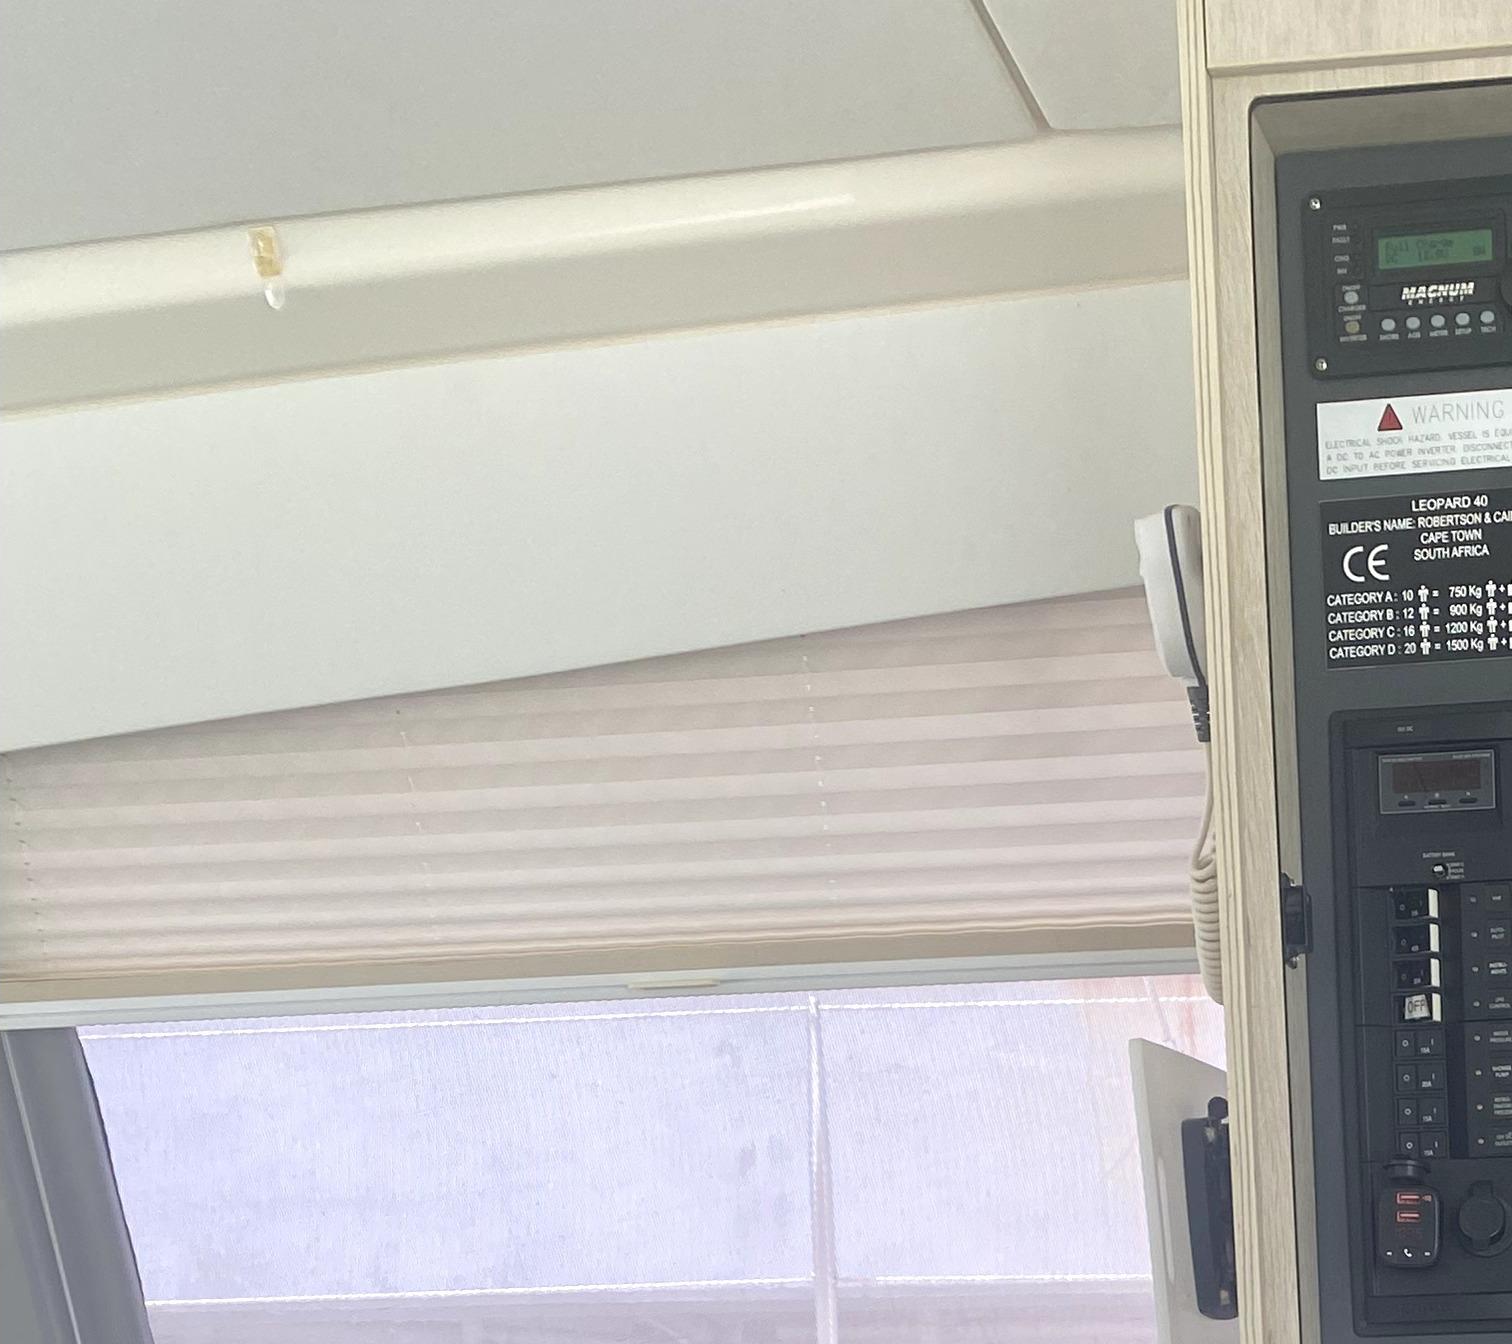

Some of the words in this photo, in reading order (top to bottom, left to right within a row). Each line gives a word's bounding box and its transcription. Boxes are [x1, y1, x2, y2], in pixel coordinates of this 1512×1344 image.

[1402, 282, 1474, 300] MAGNUM
[1412, 400, 1504, 423] WARNING
[1325, 439, 1371, 449] ELECTRICAL
[1377, 436, 1402, 446] SHOCK
[1448, 431, 1477, 440] VESSEL
[1482, 429, 1489, 438] IS
[1337, 453, 1348, 461] DC
[1354, 452, 1364, 460] TO
[1369, 451, 1379, 459] AC
[1385, 448, 1412, 457] POWER
[1463, 441, 1512, 452] DISCONNECT
[1327, 466, 1338, 475] DC
[1343, 464, 1368, 473] INPUT
[1373, 460, 1406, 471] BEFORE
[1412, 457, 1456, 468] SERVICING
[1461, 454, 1510, 465] ELECTRICAL
[1411, 496, 1471, 511] LEOPARD
[1473, 495, 1488, 507] 40
[1328, 519, 1381, 535] BUILDER'S
[1417, 513, 1482, 528] ROBERTSON
[1484, 512, 1492, 523] &
[1420, 531, 1449, 544] CAPE
[1451, 529, 1482, 542] TOWN
[1343, 544, 1389, 582] CE
[1414, 547, 1449, 561] SOUTH
[1451, 544, 1489, 558] AFRICA
[1327, 591, 1383, 606] CATEGORY
[1402, 589, 1414, 601] 10
[1448, 586, 1467, 598] 750
[1468, 585, 1482, 599] Kg
[1328, 609, 1384, 624] CATEGORY
[1402, 607, 1414, 619] 12
[1449, 604, 1468, 616] 900
[1469, 603, 1483, 617] Kg
[1328, 627, 1385, 642] CATEGORY
[1403, 625, 1415, 636] 16
[1446, 621, 1468, 634] 1200
[1470, 620, 1483, 634] Kg
[1329, 645, 1386, 659] CATEGORY
[1404, 642, 1416, 654] 20
[1446, 639, 1468, 651] 1500
[1470, 638, 1484, 652] Kg
[1407, 1000, 1426, 1012] OFF
